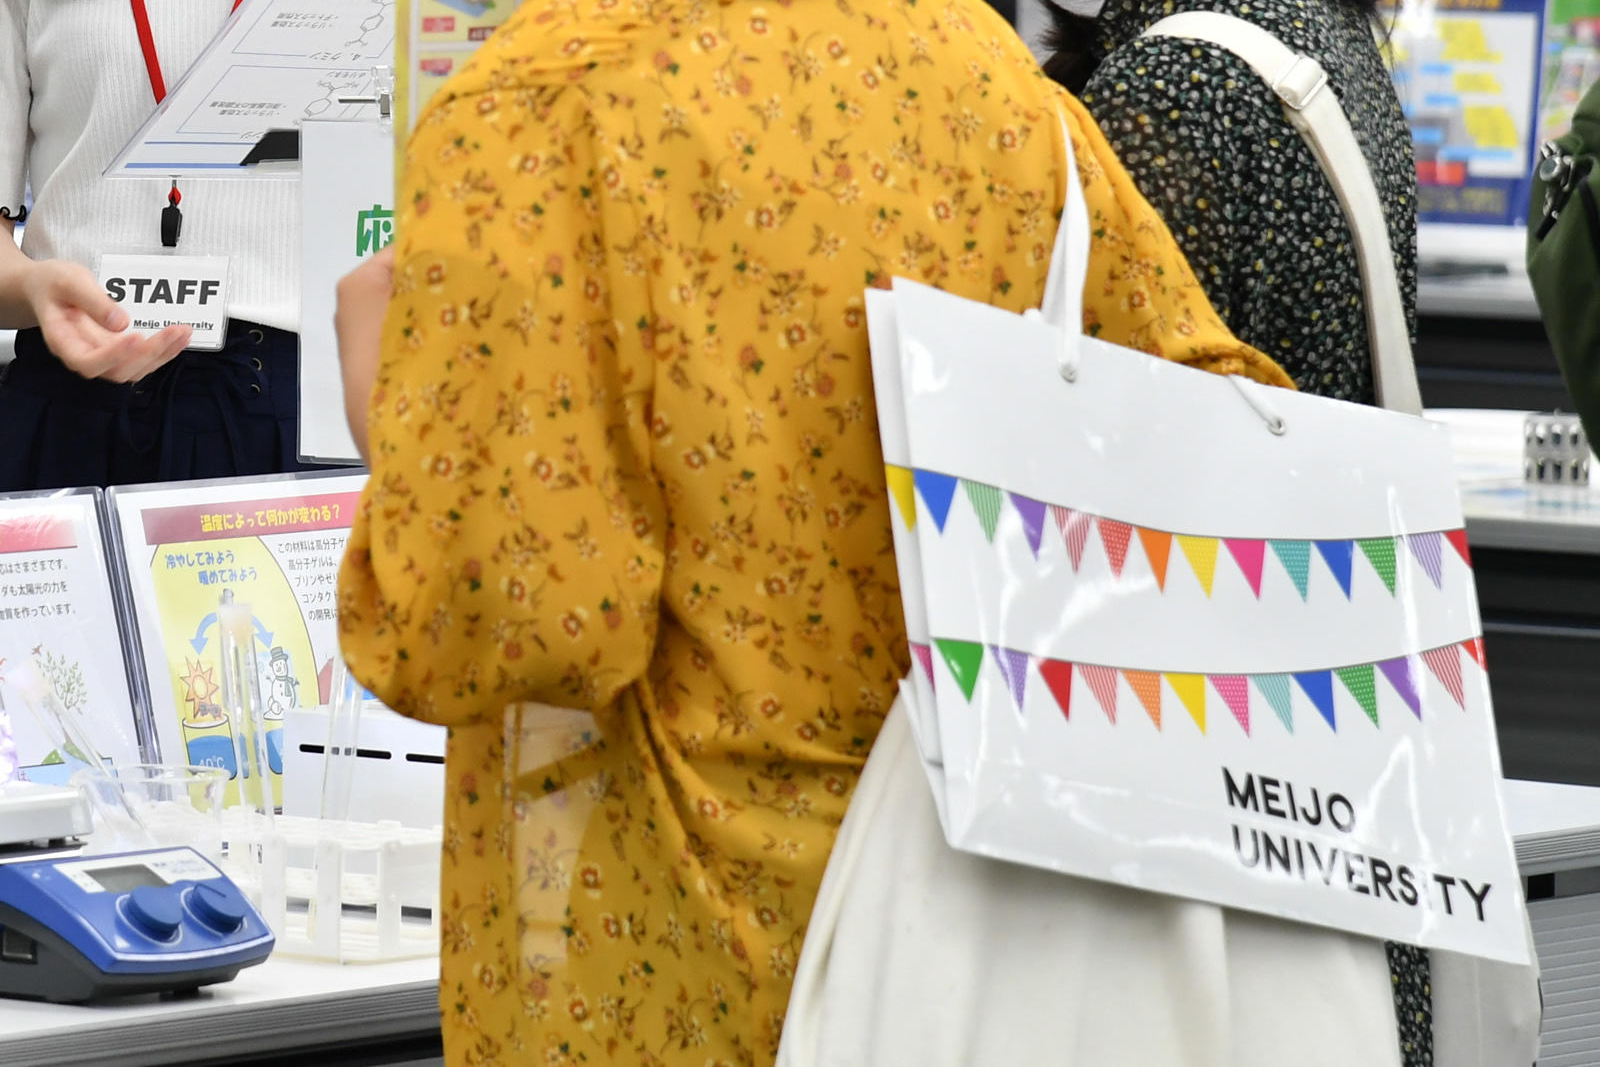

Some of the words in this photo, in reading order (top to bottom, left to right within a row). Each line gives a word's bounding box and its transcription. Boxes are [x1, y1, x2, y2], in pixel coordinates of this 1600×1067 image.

[105, 278, 220, 305] STAFF
[133, 320, 160, 329] Meijo
[200, 504, 341, 533] 温度によって何かが変わる？
[278, 538, 349, 553] この材料は高分子ゲ
[165, 550, 235, 569] 冷やしてみよう
[1221, 766, 1356, 833] MEIJO
[1232, 824, 1491, 922] UNIVERSTY
